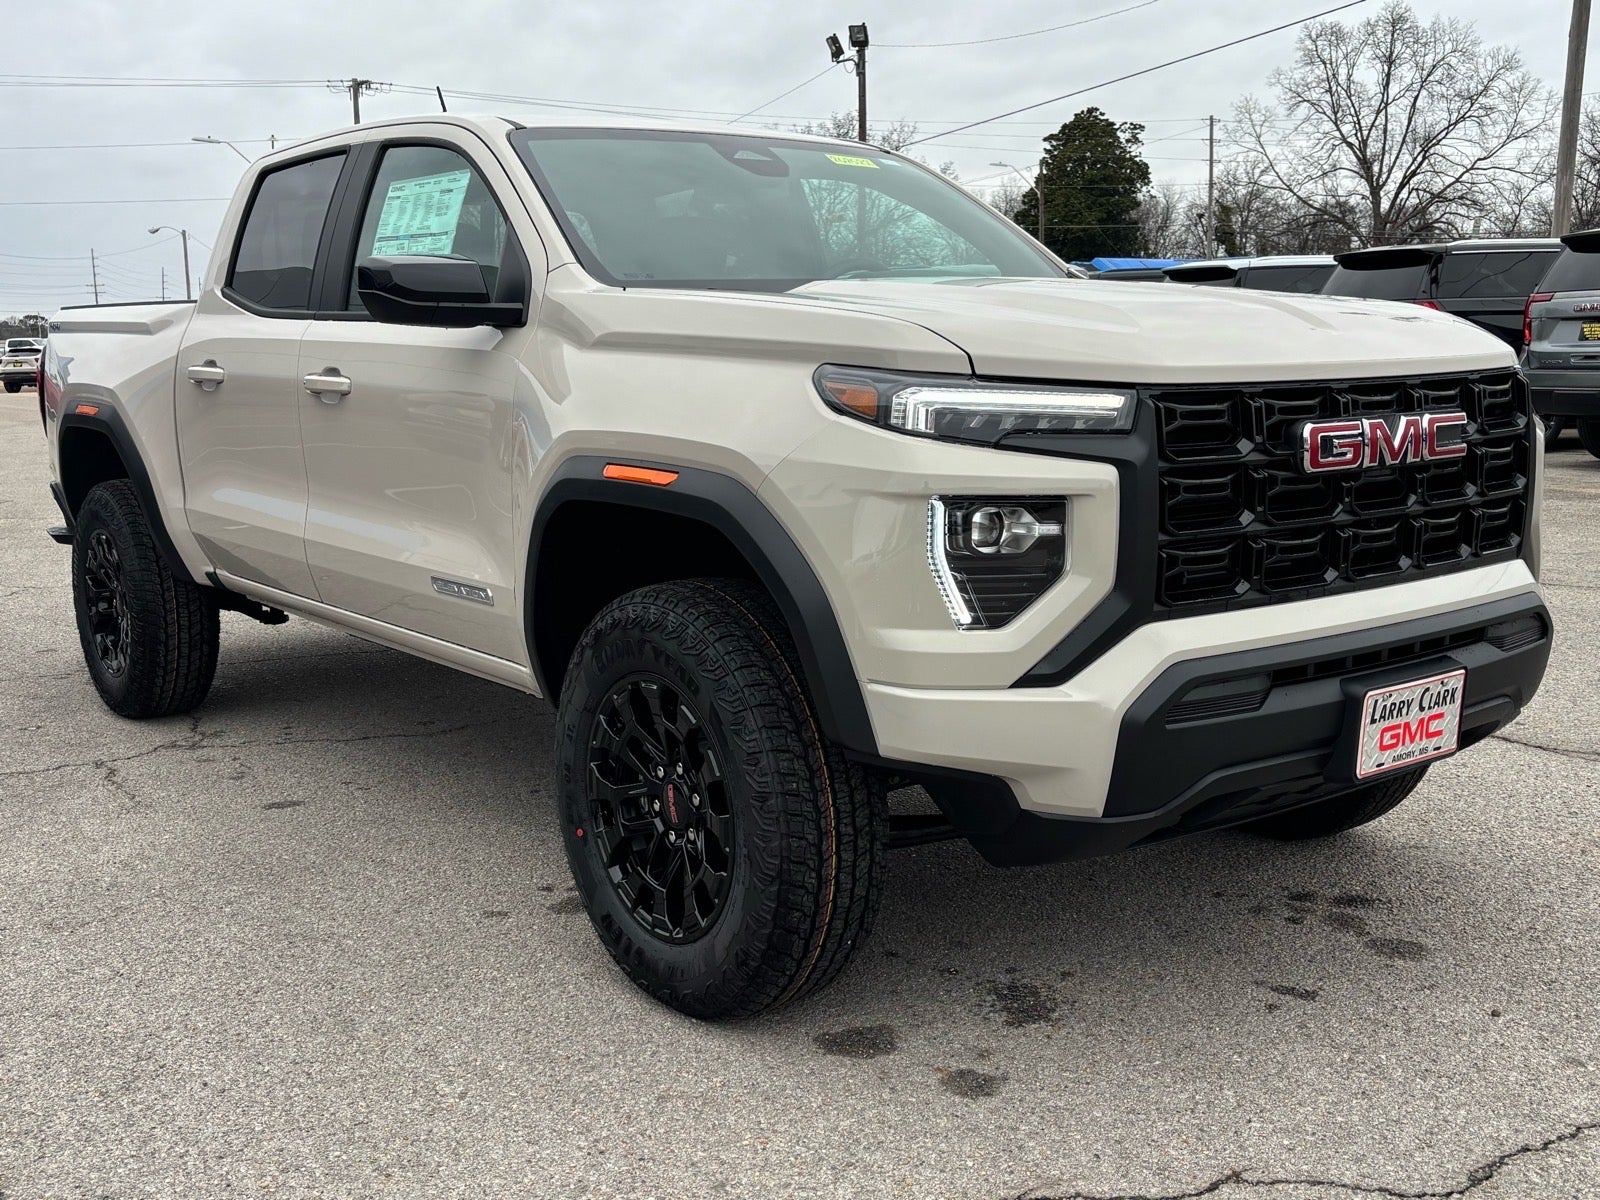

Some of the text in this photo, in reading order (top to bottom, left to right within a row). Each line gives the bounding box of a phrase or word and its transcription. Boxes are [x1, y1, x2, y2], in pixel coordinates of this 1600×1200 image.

[1303, 412, 1468, 473] GMC
[1369, 686, 1458, 725] LARRY CLARK
[1379, 712, 1445, 752] GMC
[1418, 746, 1429, 756] MS
[667, 783, 679, 824] GMC
